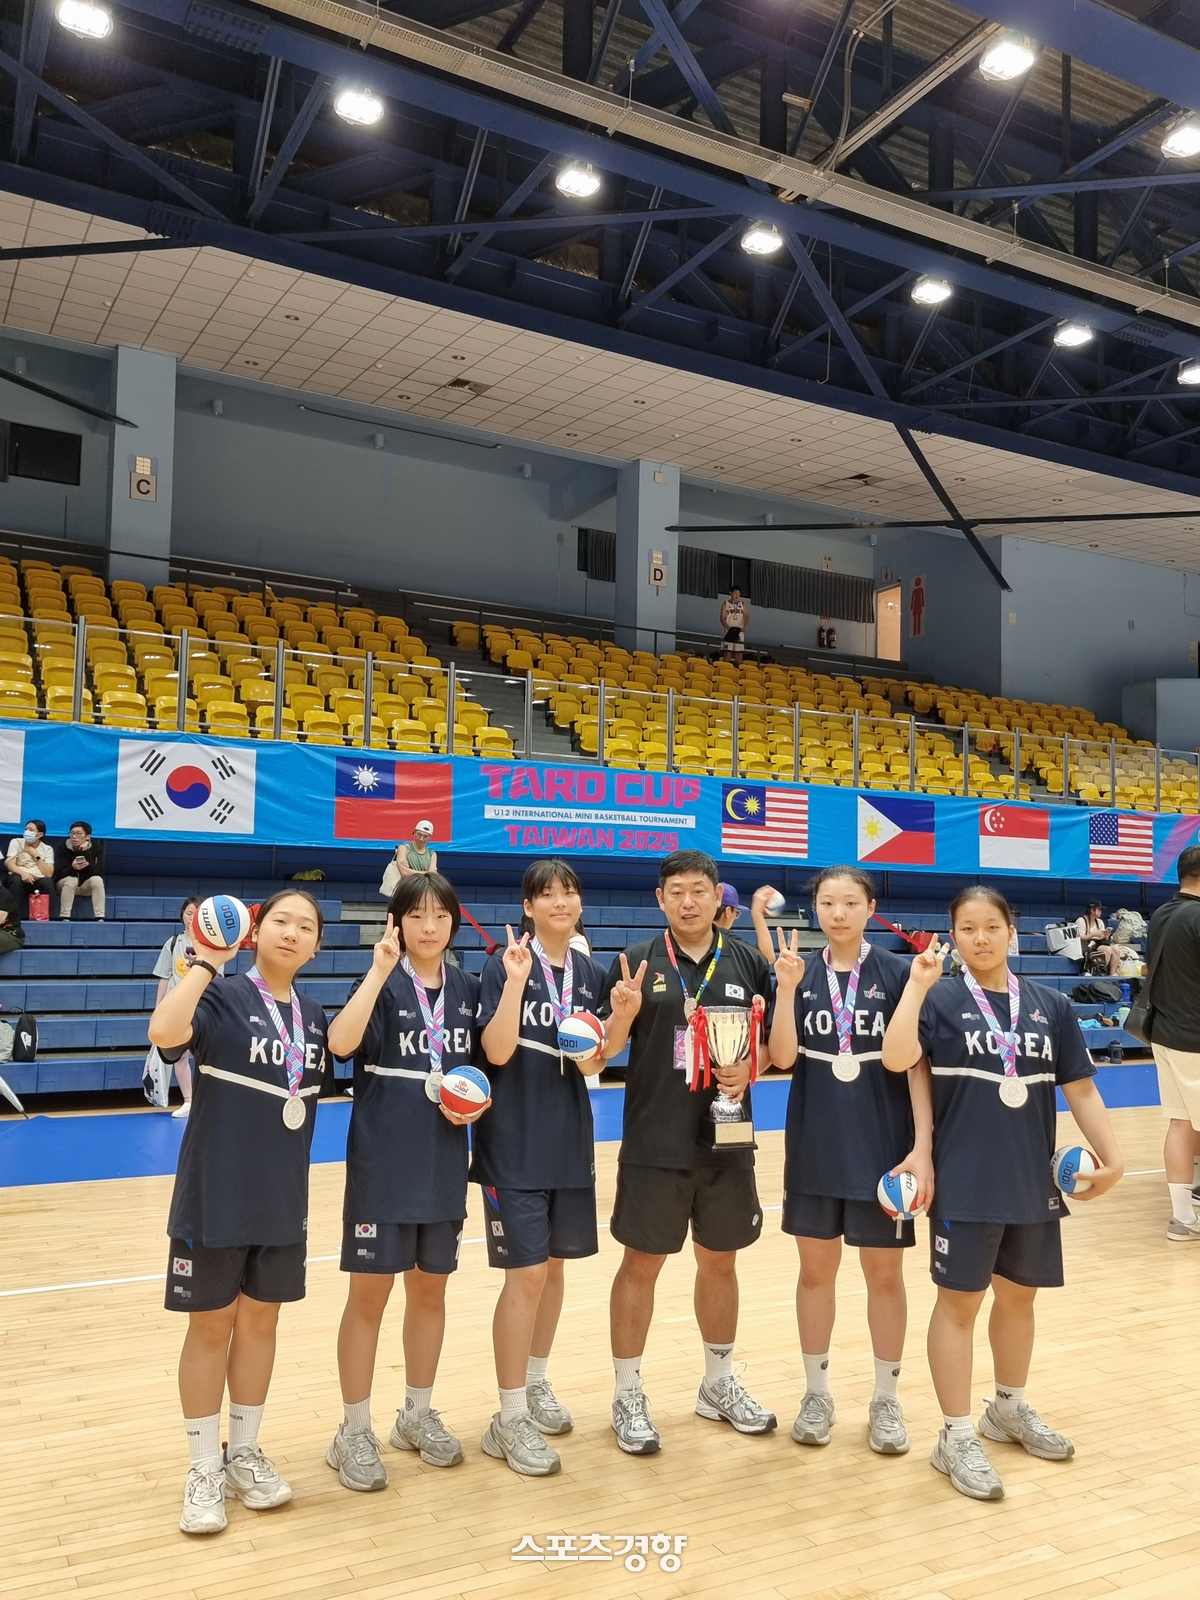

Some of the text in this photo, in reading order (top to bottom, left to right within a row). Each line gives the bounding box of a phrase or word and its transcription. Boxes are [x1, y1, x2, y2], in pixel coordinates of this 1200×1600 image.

[136, 478, 151, 496] C
[653, 567, 664, 582] D
[480, 764, 701, 809] TARO CUP
[493, 808, 688, 825] U12 INTERNATIONAL MINI BASKETBALL TOURNAMENT
[504, 824, 679, 851] TAIWAN 2025
[220, 904, 236, 930] 1000
[803, 1009, 886, 1038] KOEA
[249, 1036, 326, 1073] KOEA
[1061, 1161, 1075, 1186] 1000
